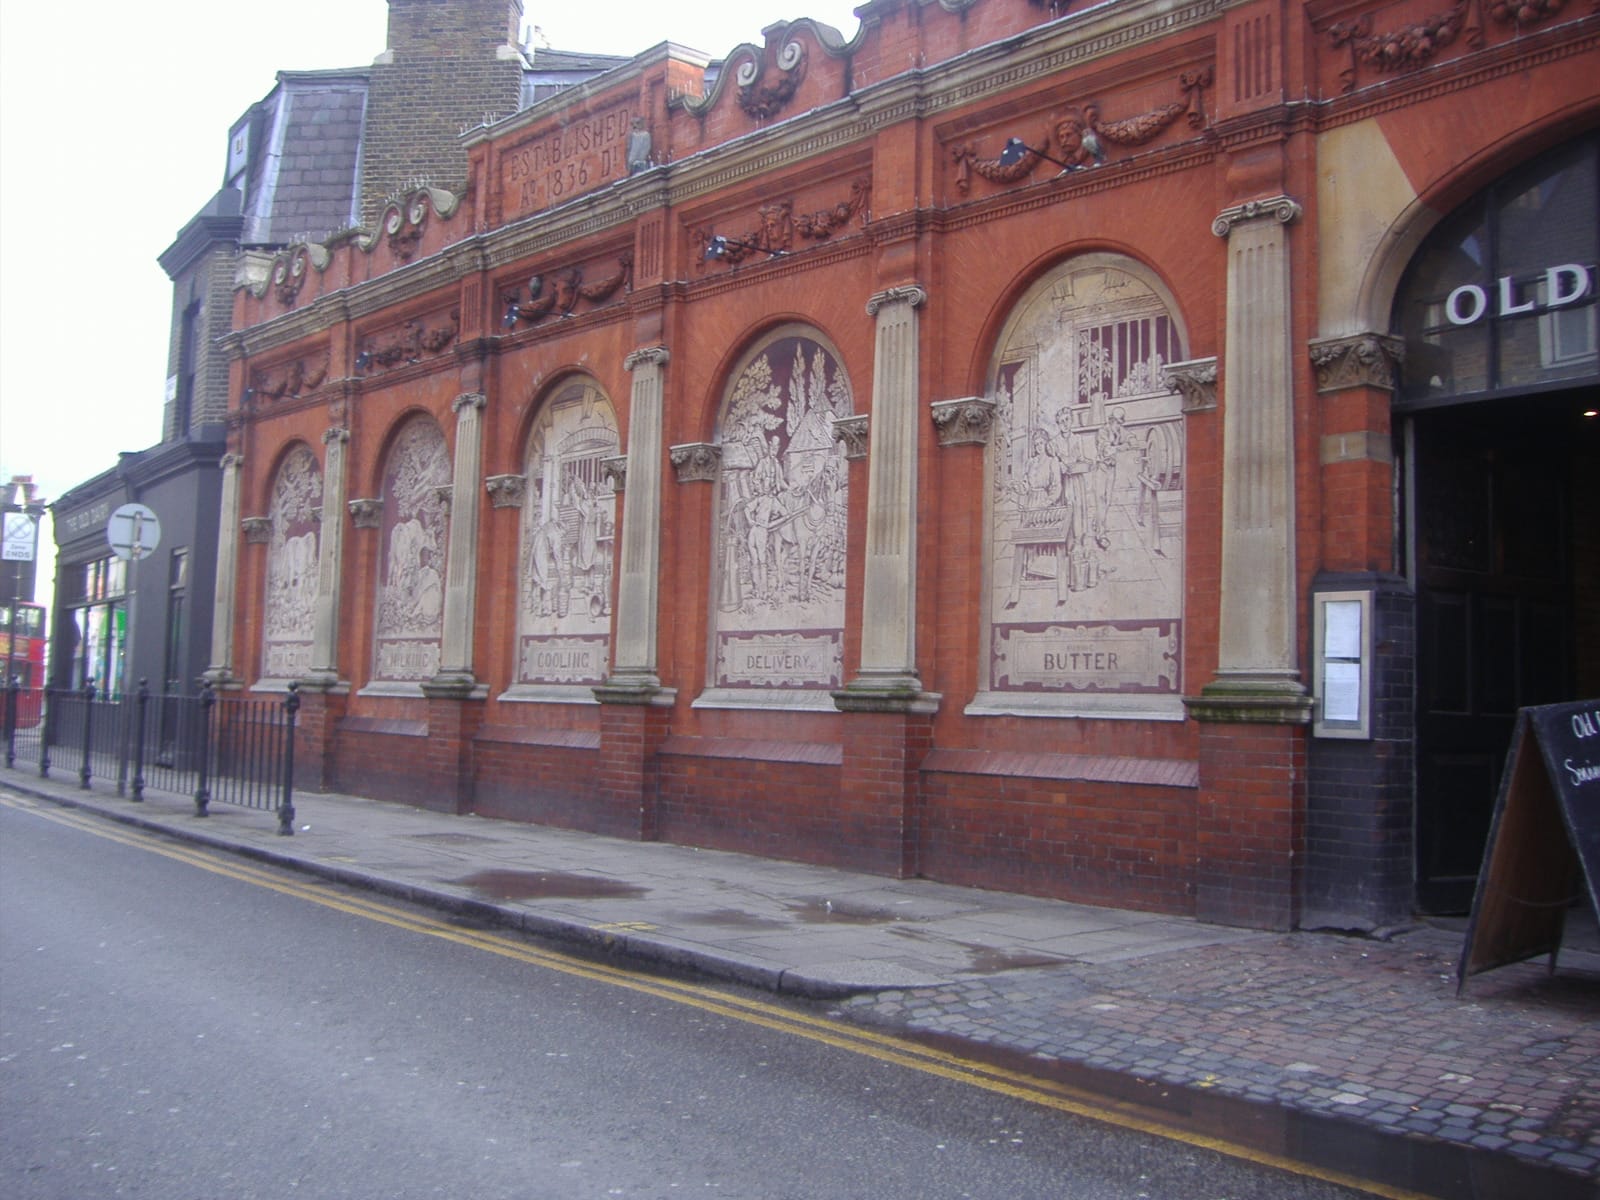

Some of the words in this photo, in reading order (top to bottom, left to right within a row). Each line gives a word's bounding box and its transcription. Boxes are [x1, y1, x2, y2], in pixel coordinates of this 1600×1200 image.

[511, 109, 629, 181] ESTABLISHED
[547, 160, 588, 199] 1836
[1445, 263, 1589, 325] OLD
[5, 550, 30, 558] ENDS
[537, 652, 589, 668] COOLING
[746, 655, 810, 669] DELIVERY
[1043, 652, 1118, 670] BUTTER
